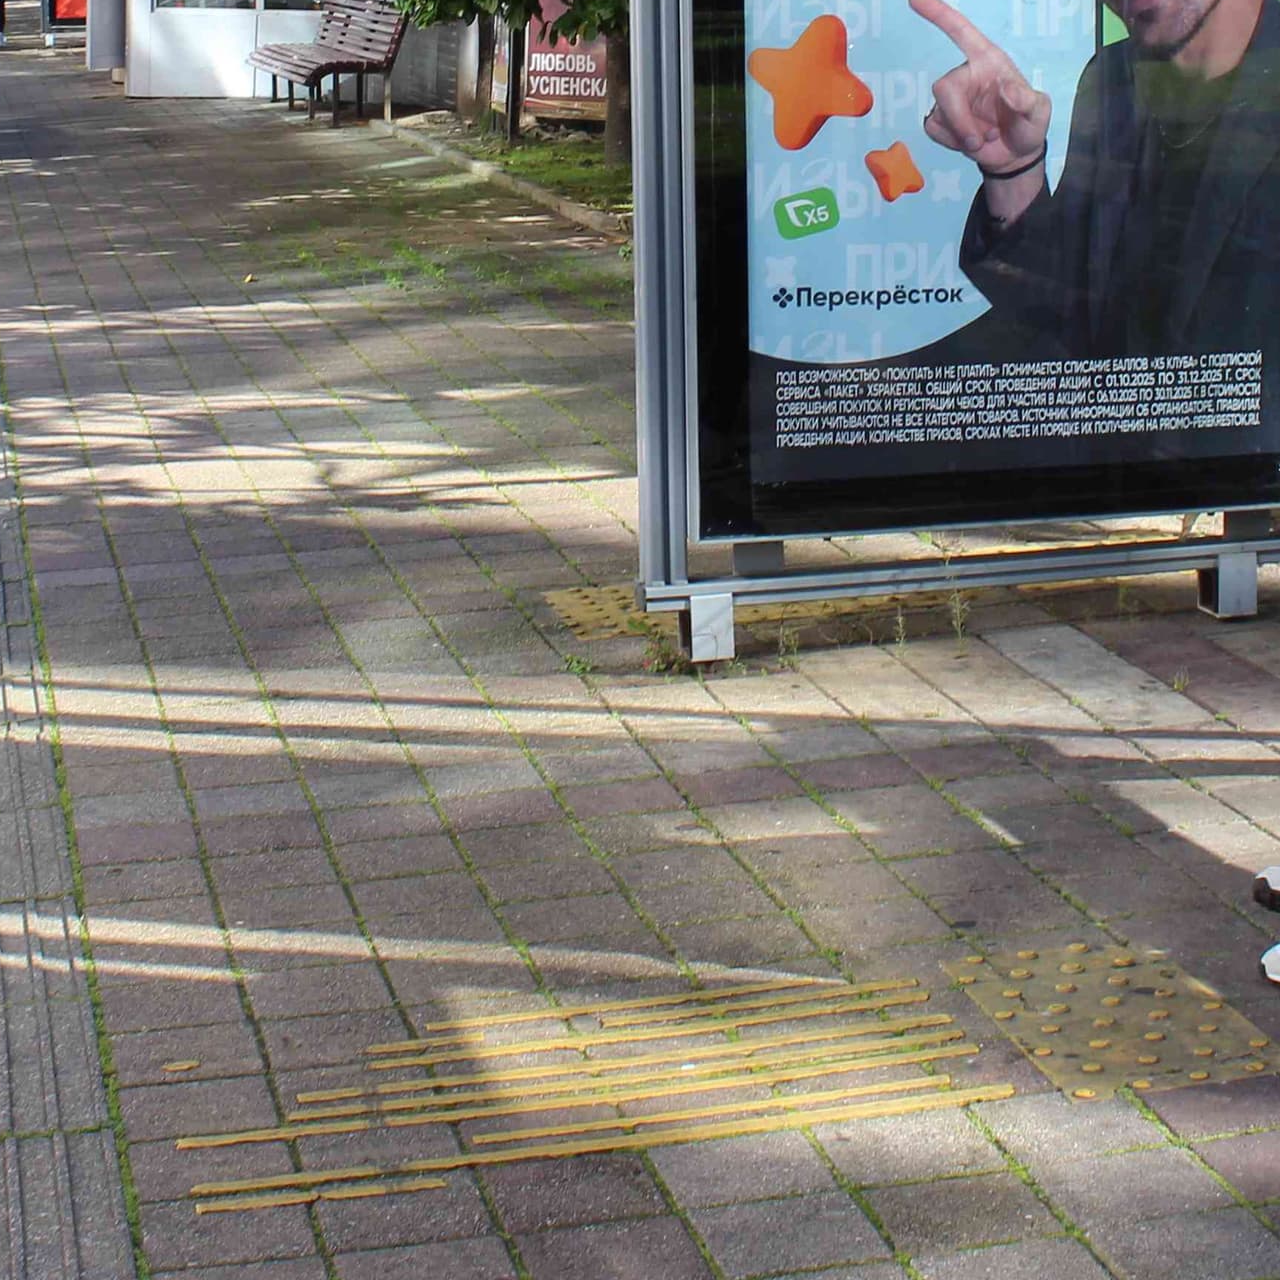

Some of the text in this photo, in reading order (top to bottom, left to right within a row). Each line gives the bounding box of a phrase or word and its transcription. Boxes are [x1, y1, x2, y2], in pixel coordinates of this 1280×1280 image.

[529, 52, 596, 73] ЛЮБОВЬ
[795, 284, 964, 311] Перекрёсток
[776, 371, 797, 385] ПОД
[799, 368, 881, 384] ВОЗМОЖНОСТЬЮ
[882, 366, 934, 381] «ПОКУПАТЬ
[935, 365, 943, 379] И
[944, 365, 957, 379] НЕ
[957, 363, 1000, 379] ПЛАТИТЬ»
[1002, 361, 1063, 376] ПОНИМАЕТСЯ
[1064, 359, 1112, 373] СПИСАНИЕ
[1112, 357, 1149, 372] БАЛЛОВ
[1200, 354, 1207, 367] С
[1209, 350, 1262, 368] ПОДПИСКОЙ
[776, 386, 821, 400] СЕРВИСА
[824, 384, 864, 398] «ПАКЕТ»
[926, 377, 963, 396] ОБЩИЙ
[965, 378, 992, 393] СРОК
[995, 377, 1057, 393] ПРОВЕДЕНИЯ
[1060, 375, 1092, 390] АКЦИИ
[1095, 374, 1103, 388] С
[1106, 372, 1155, 388] 01.10.2025
[1158, 371, 1175, 386] ПО
[1178, 369, 1223, 384] 31.12.2025
[1225, 368, 1233, 382] Г.
[1235, 368, 1262, 382] СРОК
[776, 401, 838, 416] СОВЕРШЕНИЯ
[840, 399, 883, 414] ПОКУПОК
[884, 399, 892, 412] И
[894, 396, 956, 412] РЕГИСТРАЦИИ
[957, 395, 986, 410] ЧЕКОВ
[987, 394, 1007, 409] ДЛЯ
[1007, 393, 1047, 408] УЧАСТИЯ
[1048, 392, 1055, 406] В
[1056, 390, 1087, 406] АКЦИИ
[1088, 390, 1096, 404] С
[1140, 388, 1154, 401] ПО
[1201, 385, 1207, 398] В
[1208, 382, 1262, 398] СТОИМОСТИ
[776, 417, 819, 431] ПОКУПКИ
[821, 414, 890, 429] УЧИТЫВАЮТСЯ
[892, 413, 904, 427] НЕ
[905, 412, 924, 427] ВСЕ
[925, 410, 976, 426] КАТЕГОРИИ
[1022, 407, 1070, 422] ИСТОЧНИК
[1071, 404, 1135, 420] ИНФОРМАЦИИ
[1136, 403, 1150, 417] ОБ
[1216, 398, 1261, 413] ПРАВИЛАХ
[776, 432, 834, 448] ПРОВЕДЕНИЯ
[869, 427, 926, 444] КОЛИЧЕСТВЕ
[1003, 423, 1031, 438] МЕСТЕ
[1032, 423, 1040, 437] И
[1040, 421, 1081, 437] ПОРЯДКЕ
[1081, 420, 1094, 434] ИХ
[1095, 418, 1145, 434] ПОЛУЧЕНИЯ
[1146, 417, 1159, 431] НА
